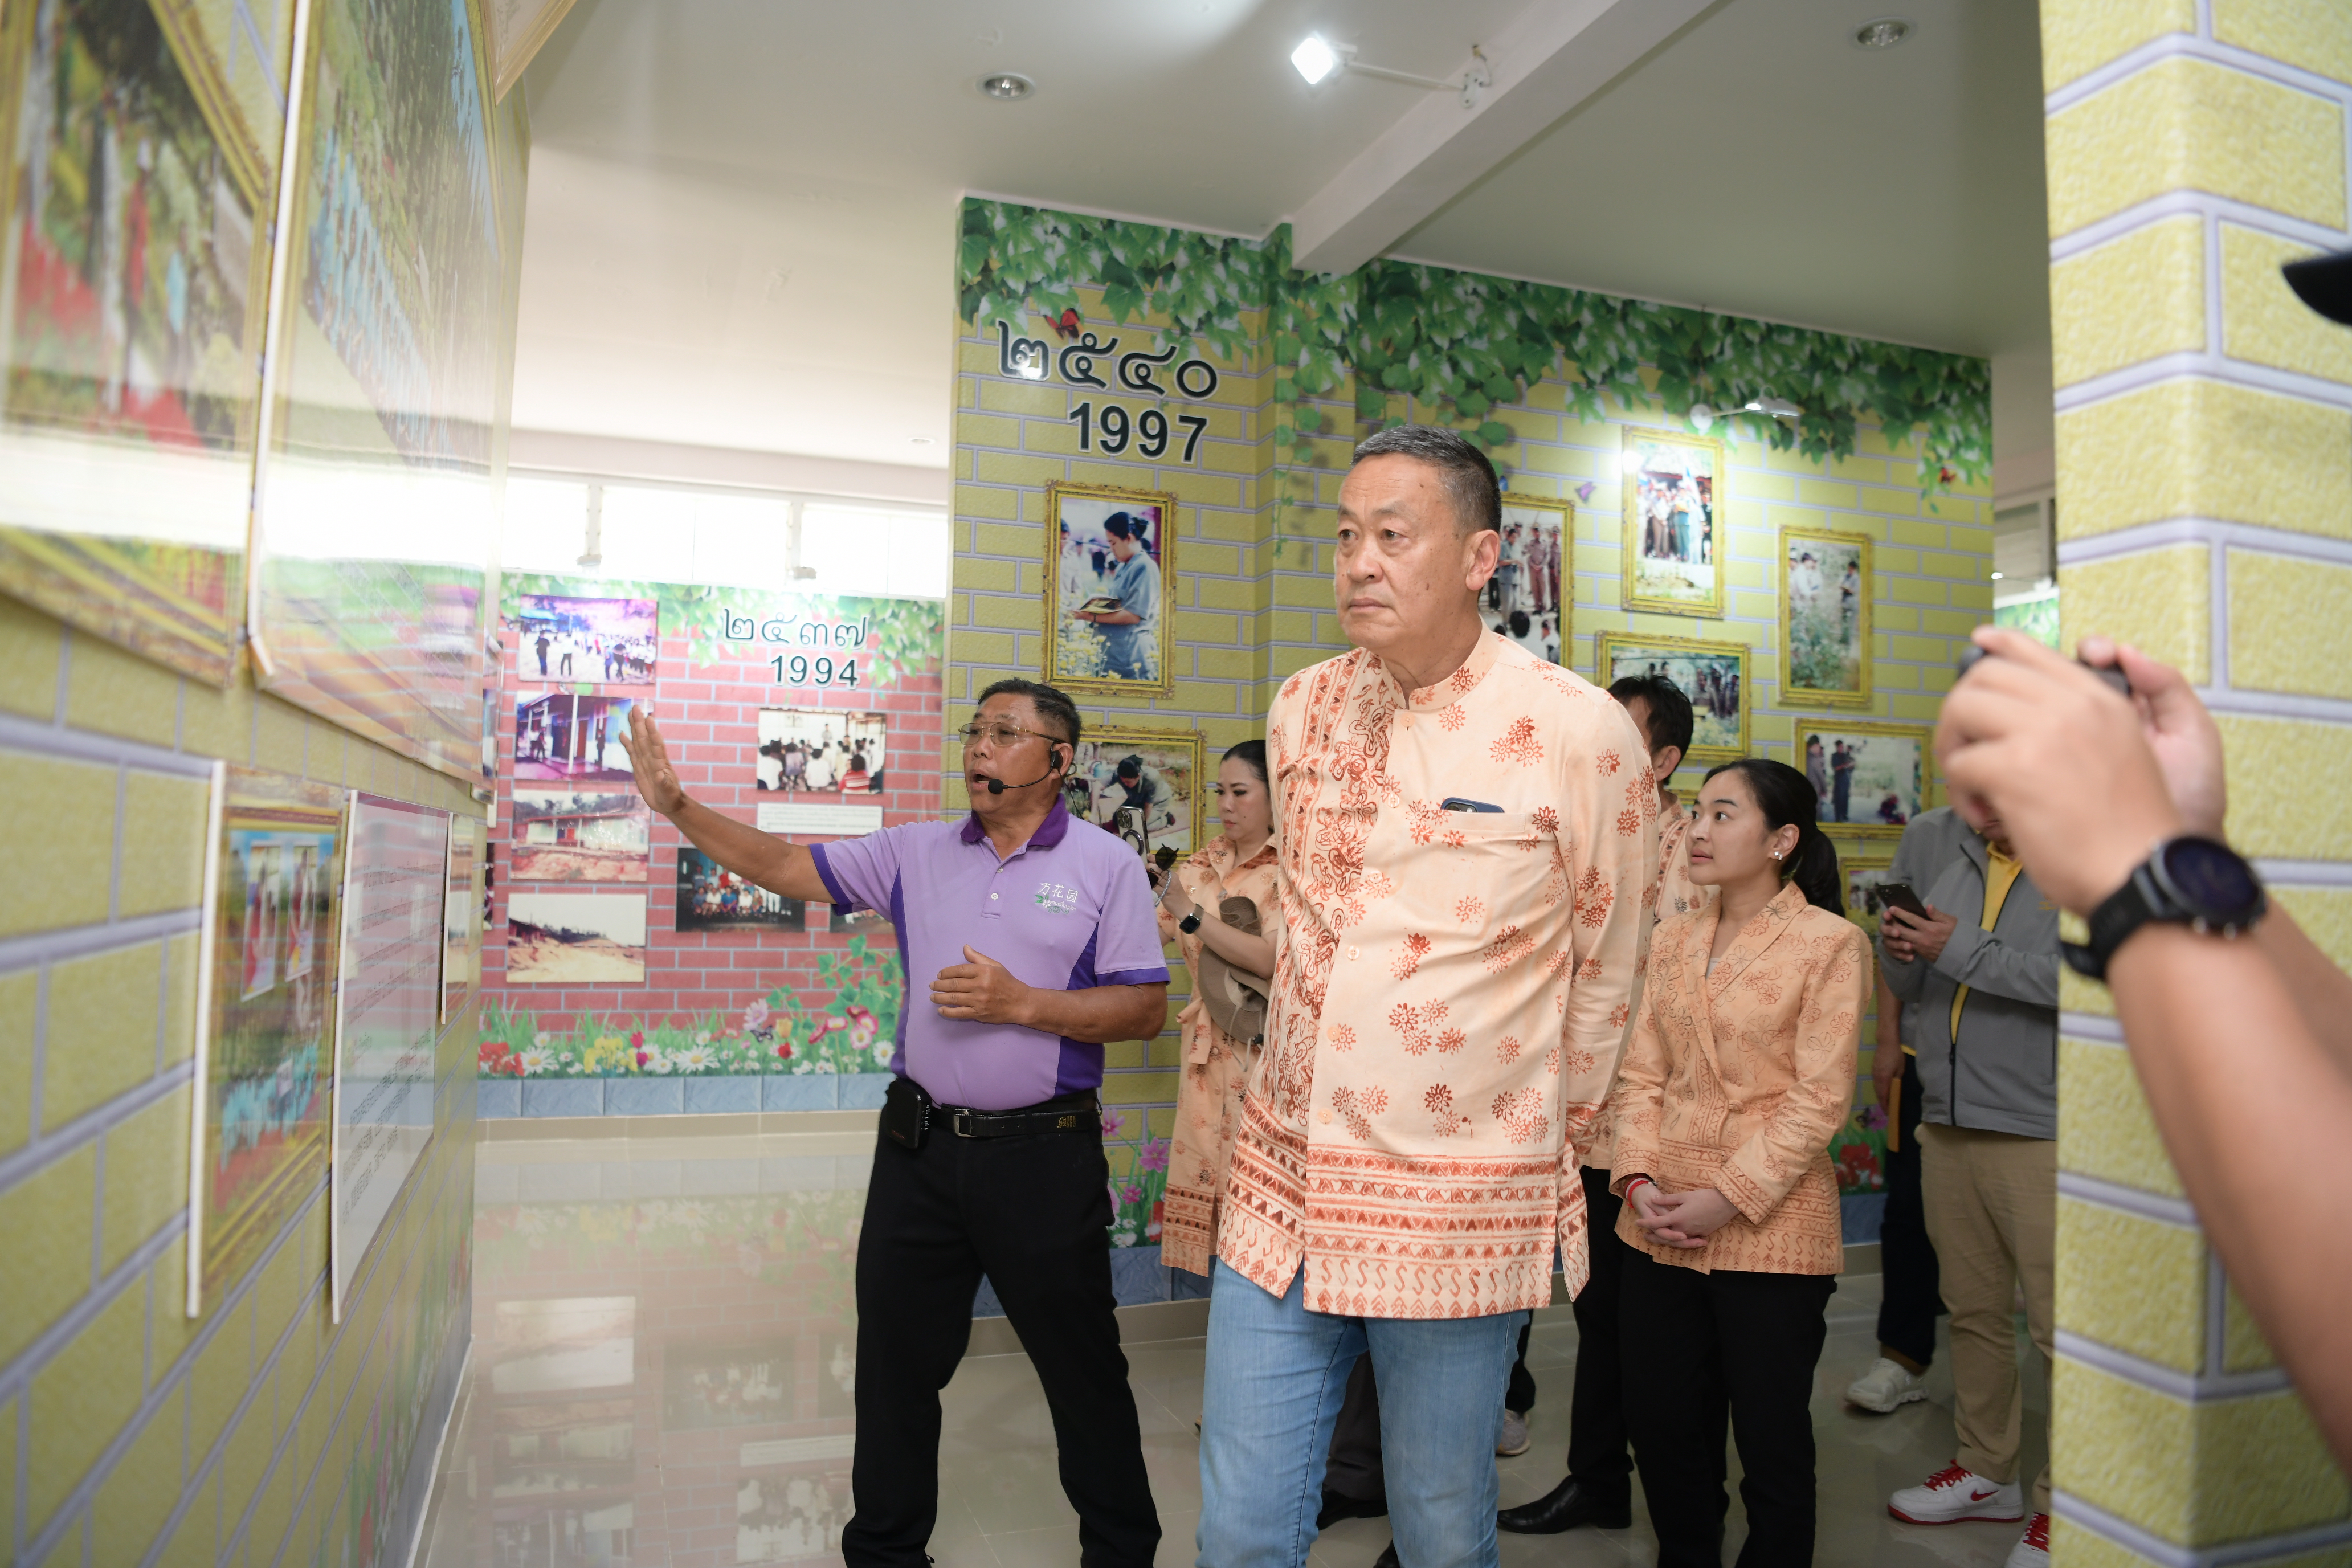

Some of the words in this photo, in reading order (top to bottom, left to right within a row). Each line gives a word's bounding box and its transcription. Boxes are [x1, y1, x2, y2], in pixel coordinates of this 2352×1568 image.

[998, 320, 1218, 398] ๒๕๔๐
[1069, 402, 1208, 463] 1997
[723, 608, 869, 648] ๒๕๓๗
[770, 655, 859, 688] 1994
[1036, 883, 1078, 903] 万花园
